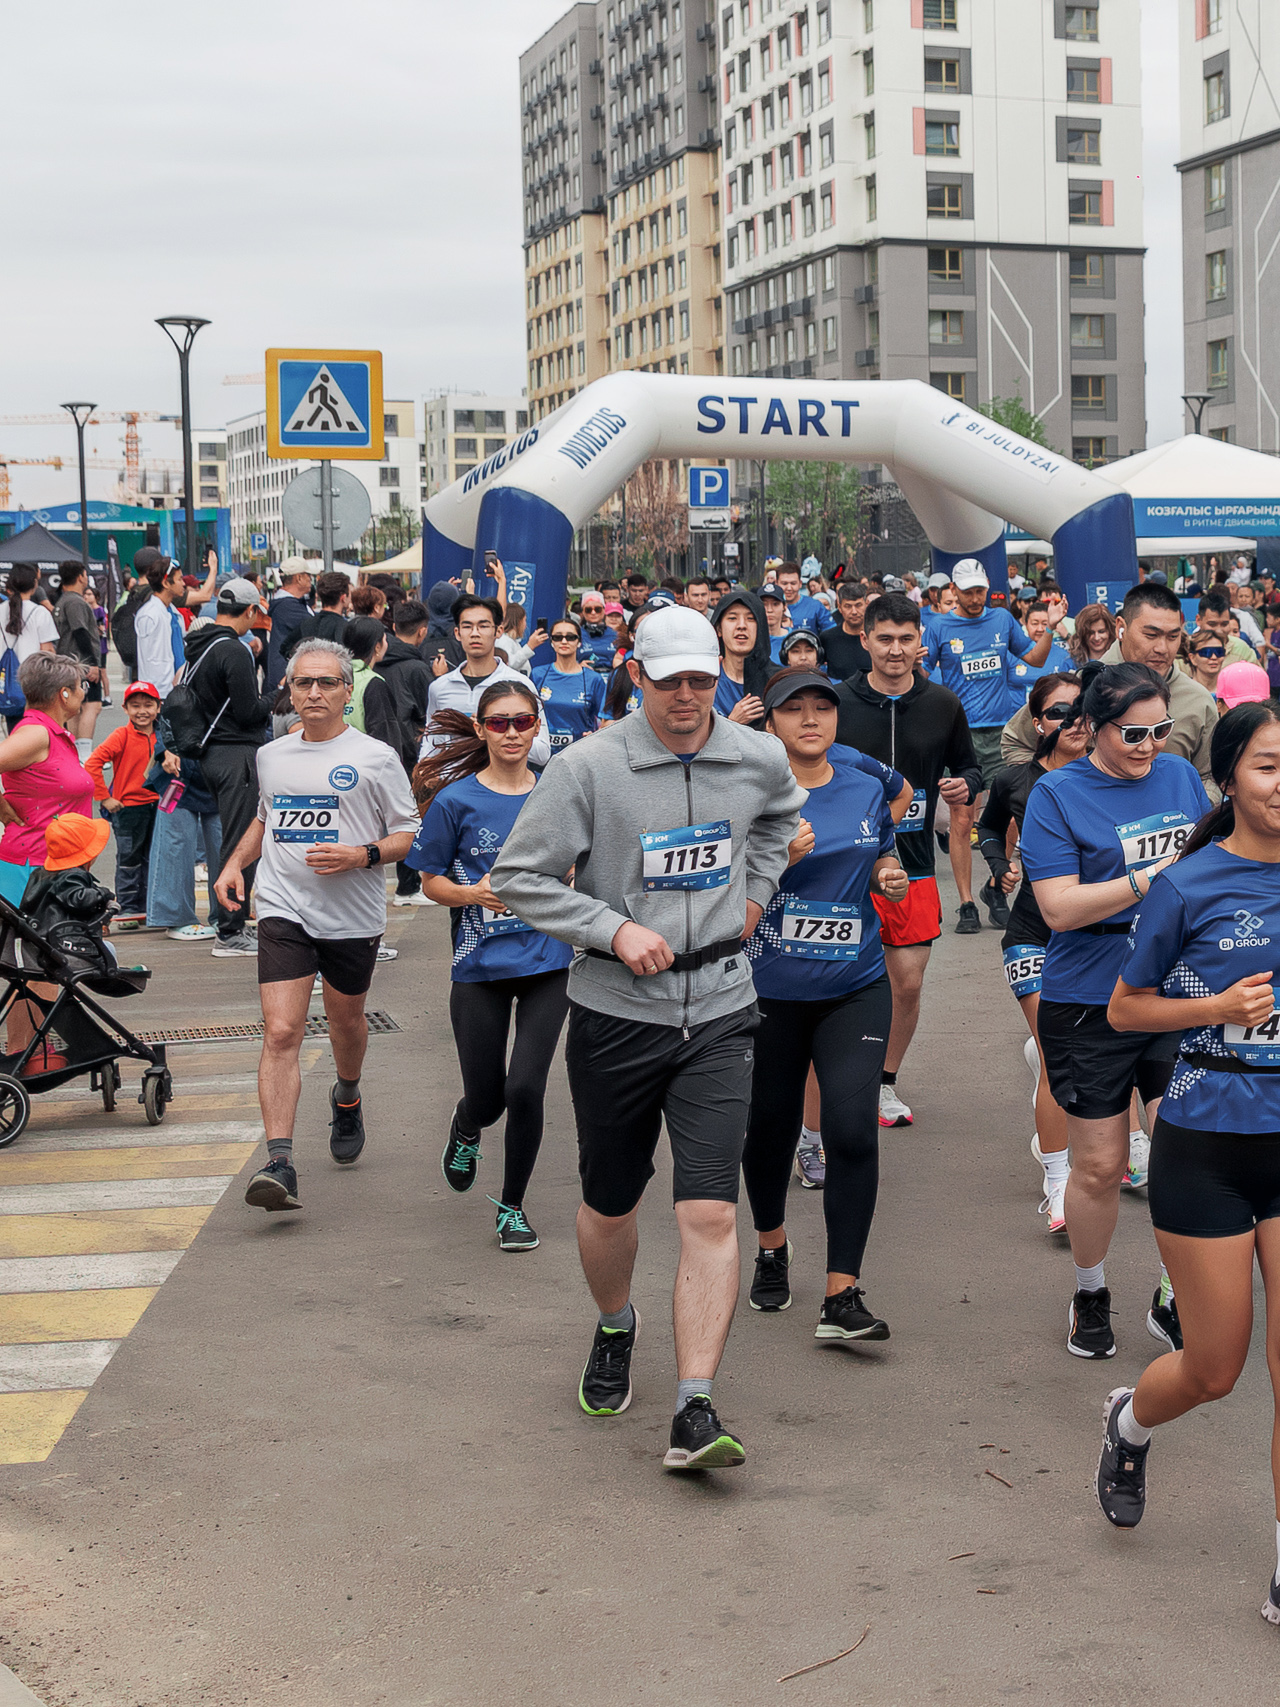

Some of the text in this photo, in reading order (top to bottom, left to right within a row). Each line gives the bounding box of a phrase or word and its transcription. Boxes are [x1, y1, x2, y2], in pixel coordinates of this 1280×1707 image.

[697, 395, 860, 437] START
[557, 407, 627, 470] INVICTUS
[965, 421, 1060, 474] BI JULDYZAI
[462, 427, 540, 494] INVICTUS
[699, 469, 723, 505] P
[1184, 519, 1191, 527] В
[1192, 518, 1223, 527] РИТМЕ
[255, 534, 265, 548] P
[508, 566, 533, 606] City
[967, 658, 996, 672] 1866
[278, 810, 332, 828] 1700
[1121, 823, 1141, 834] 5 KM
[645, 835, 669, 844] 5 KM
[1137, 828, 1187, 859] 1178
[663, 843, 719, 874] 1113
[788, 901, 809, 911] 5 KM
[793, 918, 853, 941] 1738
[1235, 937, 1271, 949] GROUP
[1006, 956, 1045, 984] 1655
